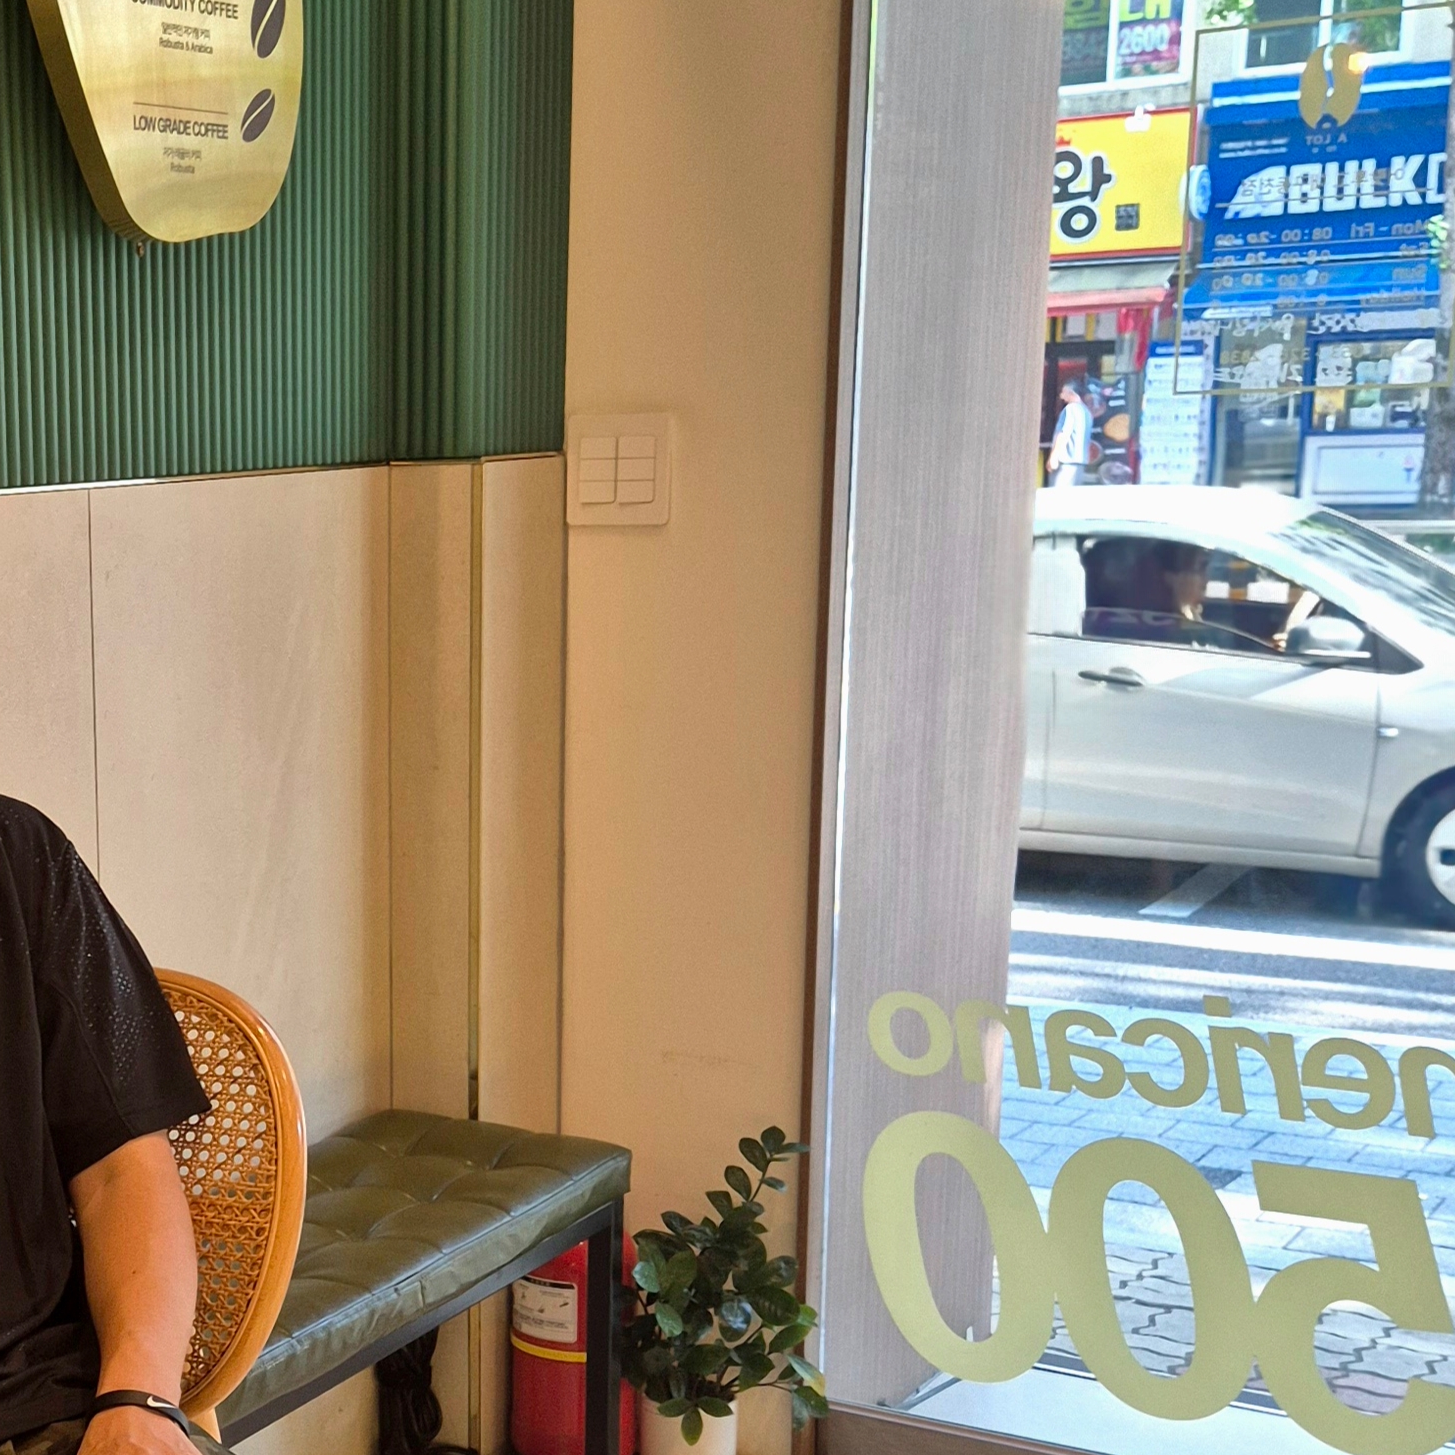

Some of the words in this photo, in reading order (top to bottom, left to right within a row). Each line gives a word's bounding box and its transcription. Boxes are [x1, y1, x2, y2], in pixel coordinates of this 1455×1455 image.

[132, 0, 196, 13] ODITY
[198, 0, 240, 20] COFFEE
[133, 115, 156, 132] LOW
[157, 118, 192, 136] GRADE
[192, 121, 229, 140] COFFEE
